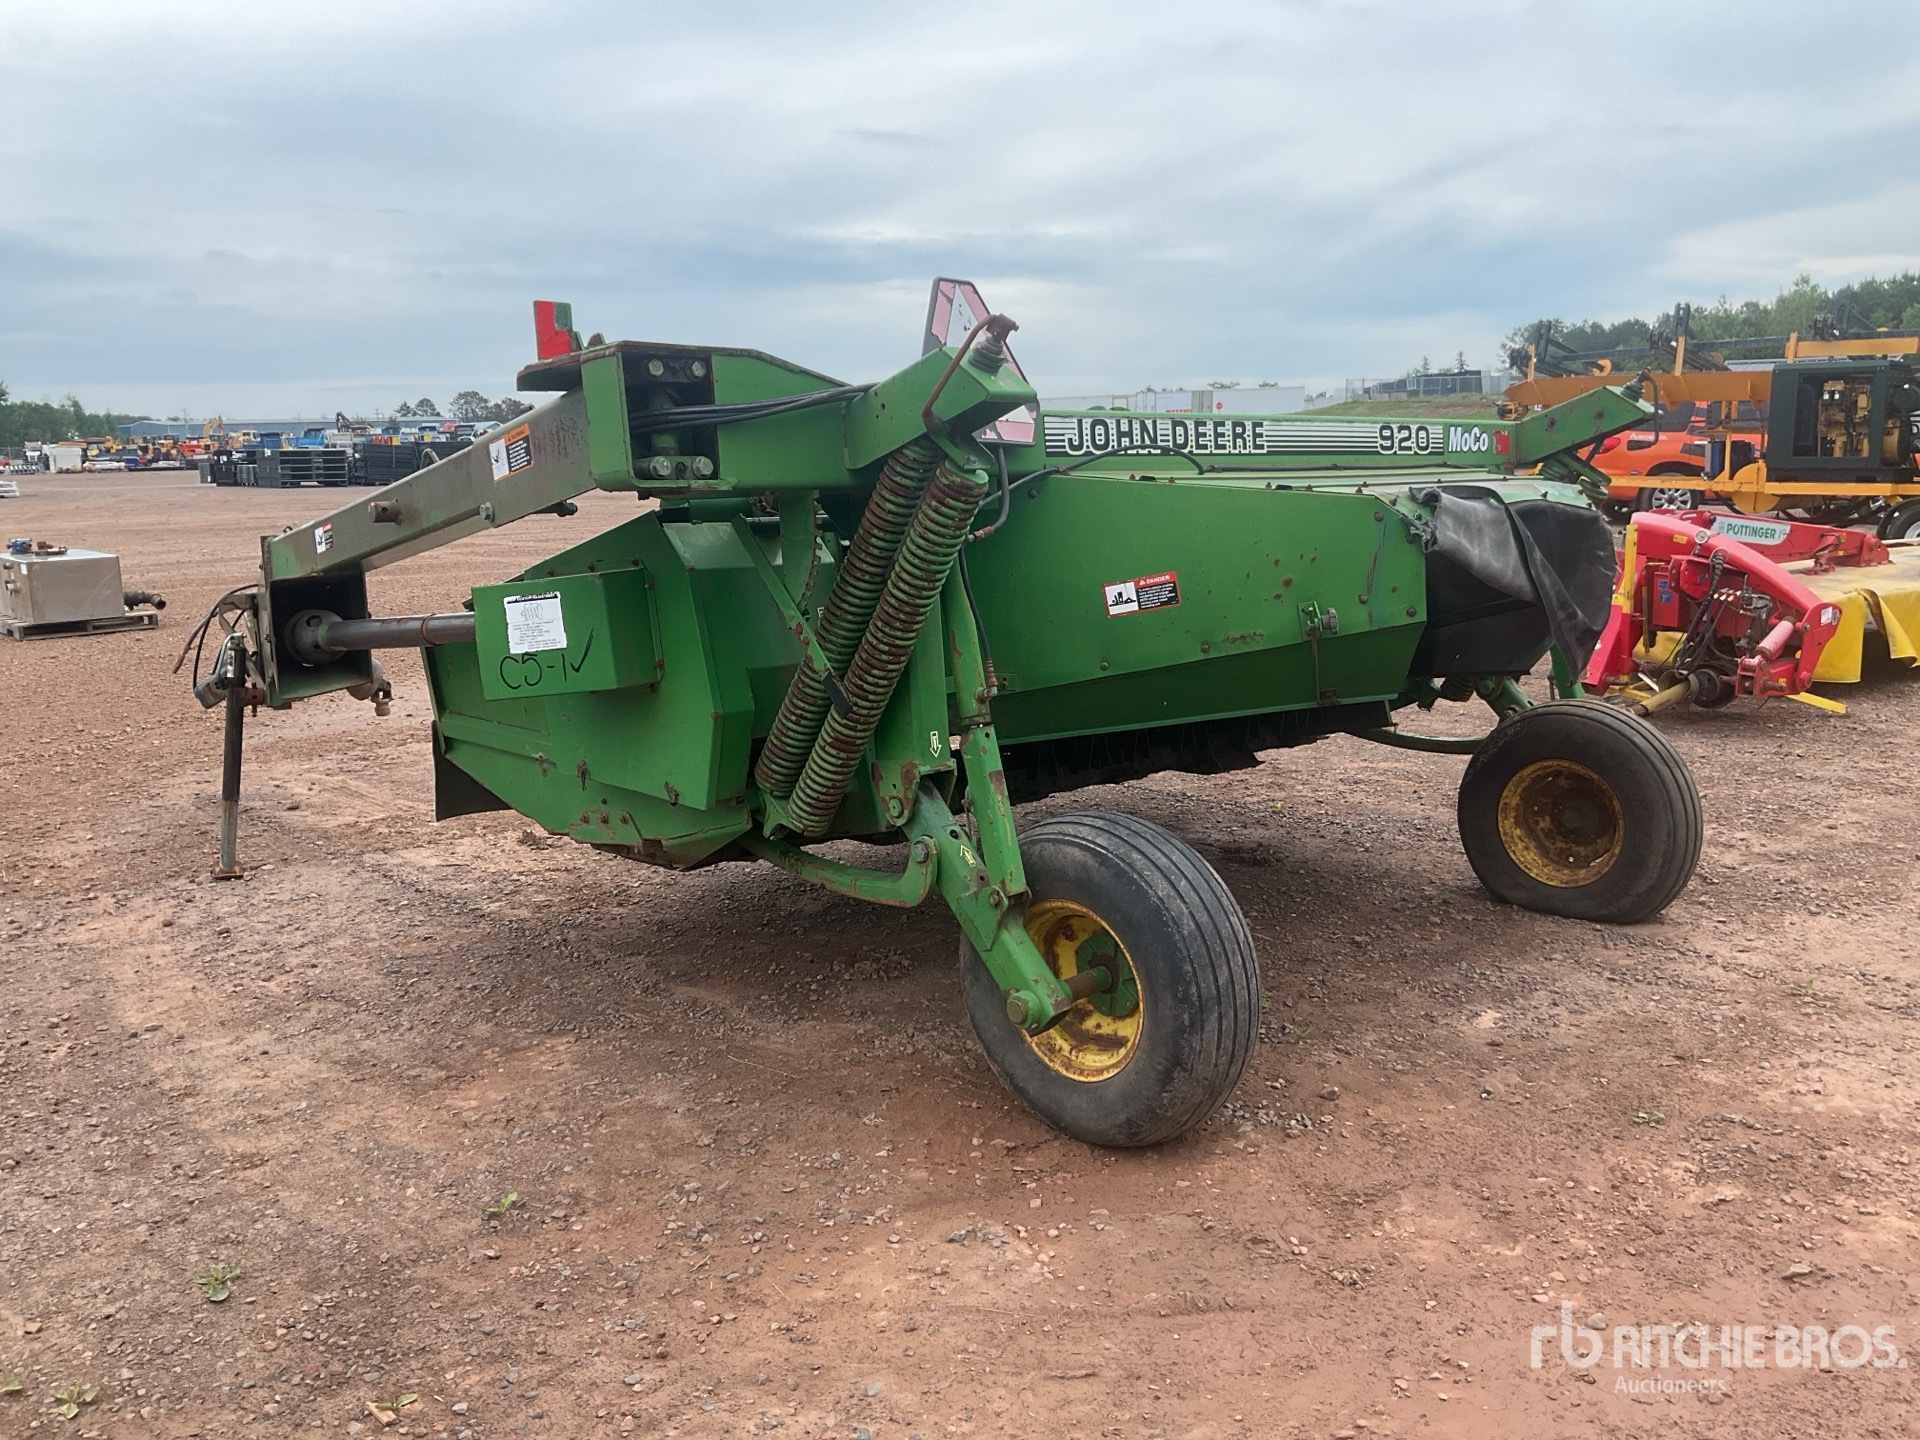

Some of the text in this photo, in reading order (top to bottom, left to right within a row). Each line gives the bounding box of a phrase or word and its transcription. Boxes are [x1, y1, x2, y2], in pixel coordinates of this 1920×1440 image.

[1066, 418, 1267, 454] JOHN DEERE
[1378, 423, 1431, 455] 920
[1448, 425, 1489, 452] MoCo
[1146, 575, 1170, 584] DANGER
